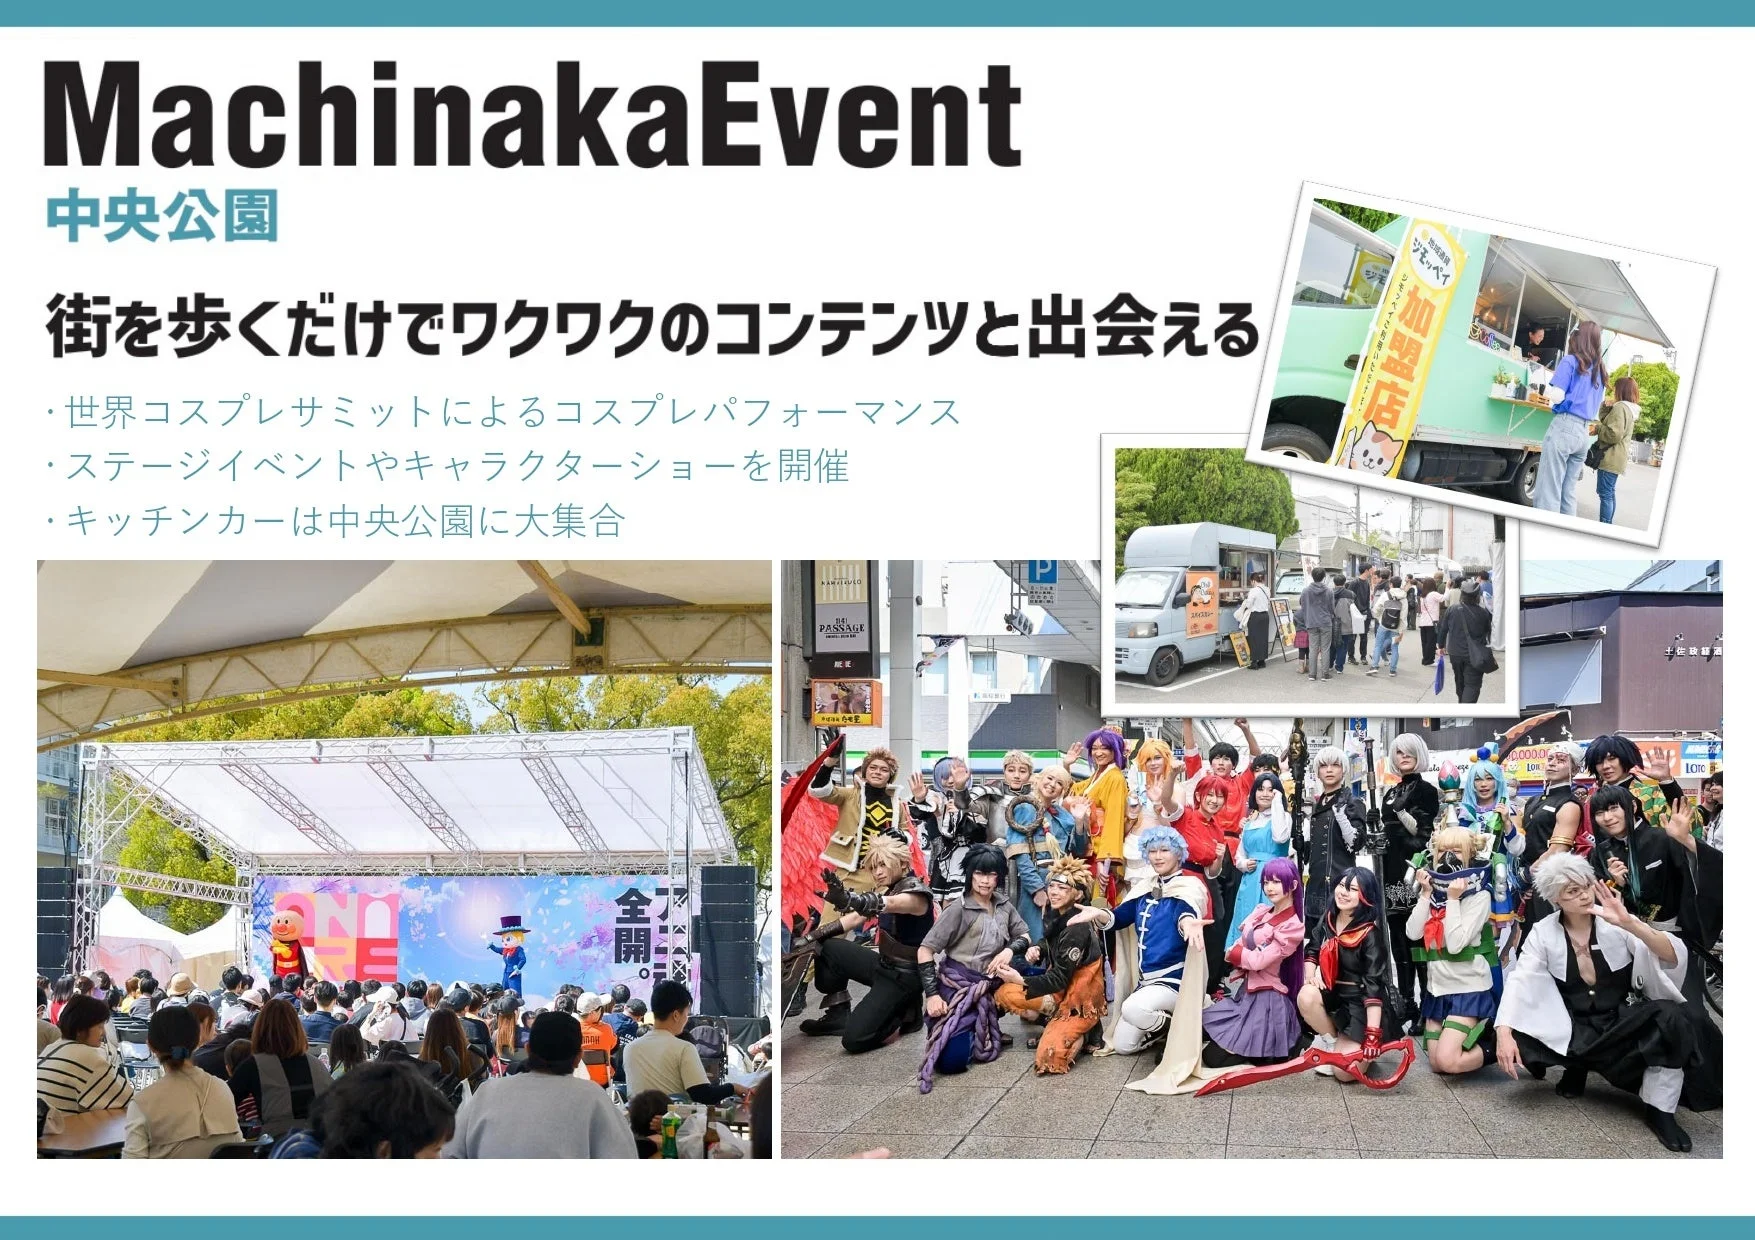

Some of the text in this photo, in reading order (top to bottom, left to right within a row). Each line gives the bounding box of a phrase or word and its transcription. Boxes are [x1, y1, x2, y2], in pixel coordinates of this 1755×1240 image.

[1412, 237, 1450, 286] ジモッペイ
[1362, 284, 1436, 431] 加盟店
[819, 624, 865, 633] PASSAGE
[614, 887, 653, 980] 全開。
